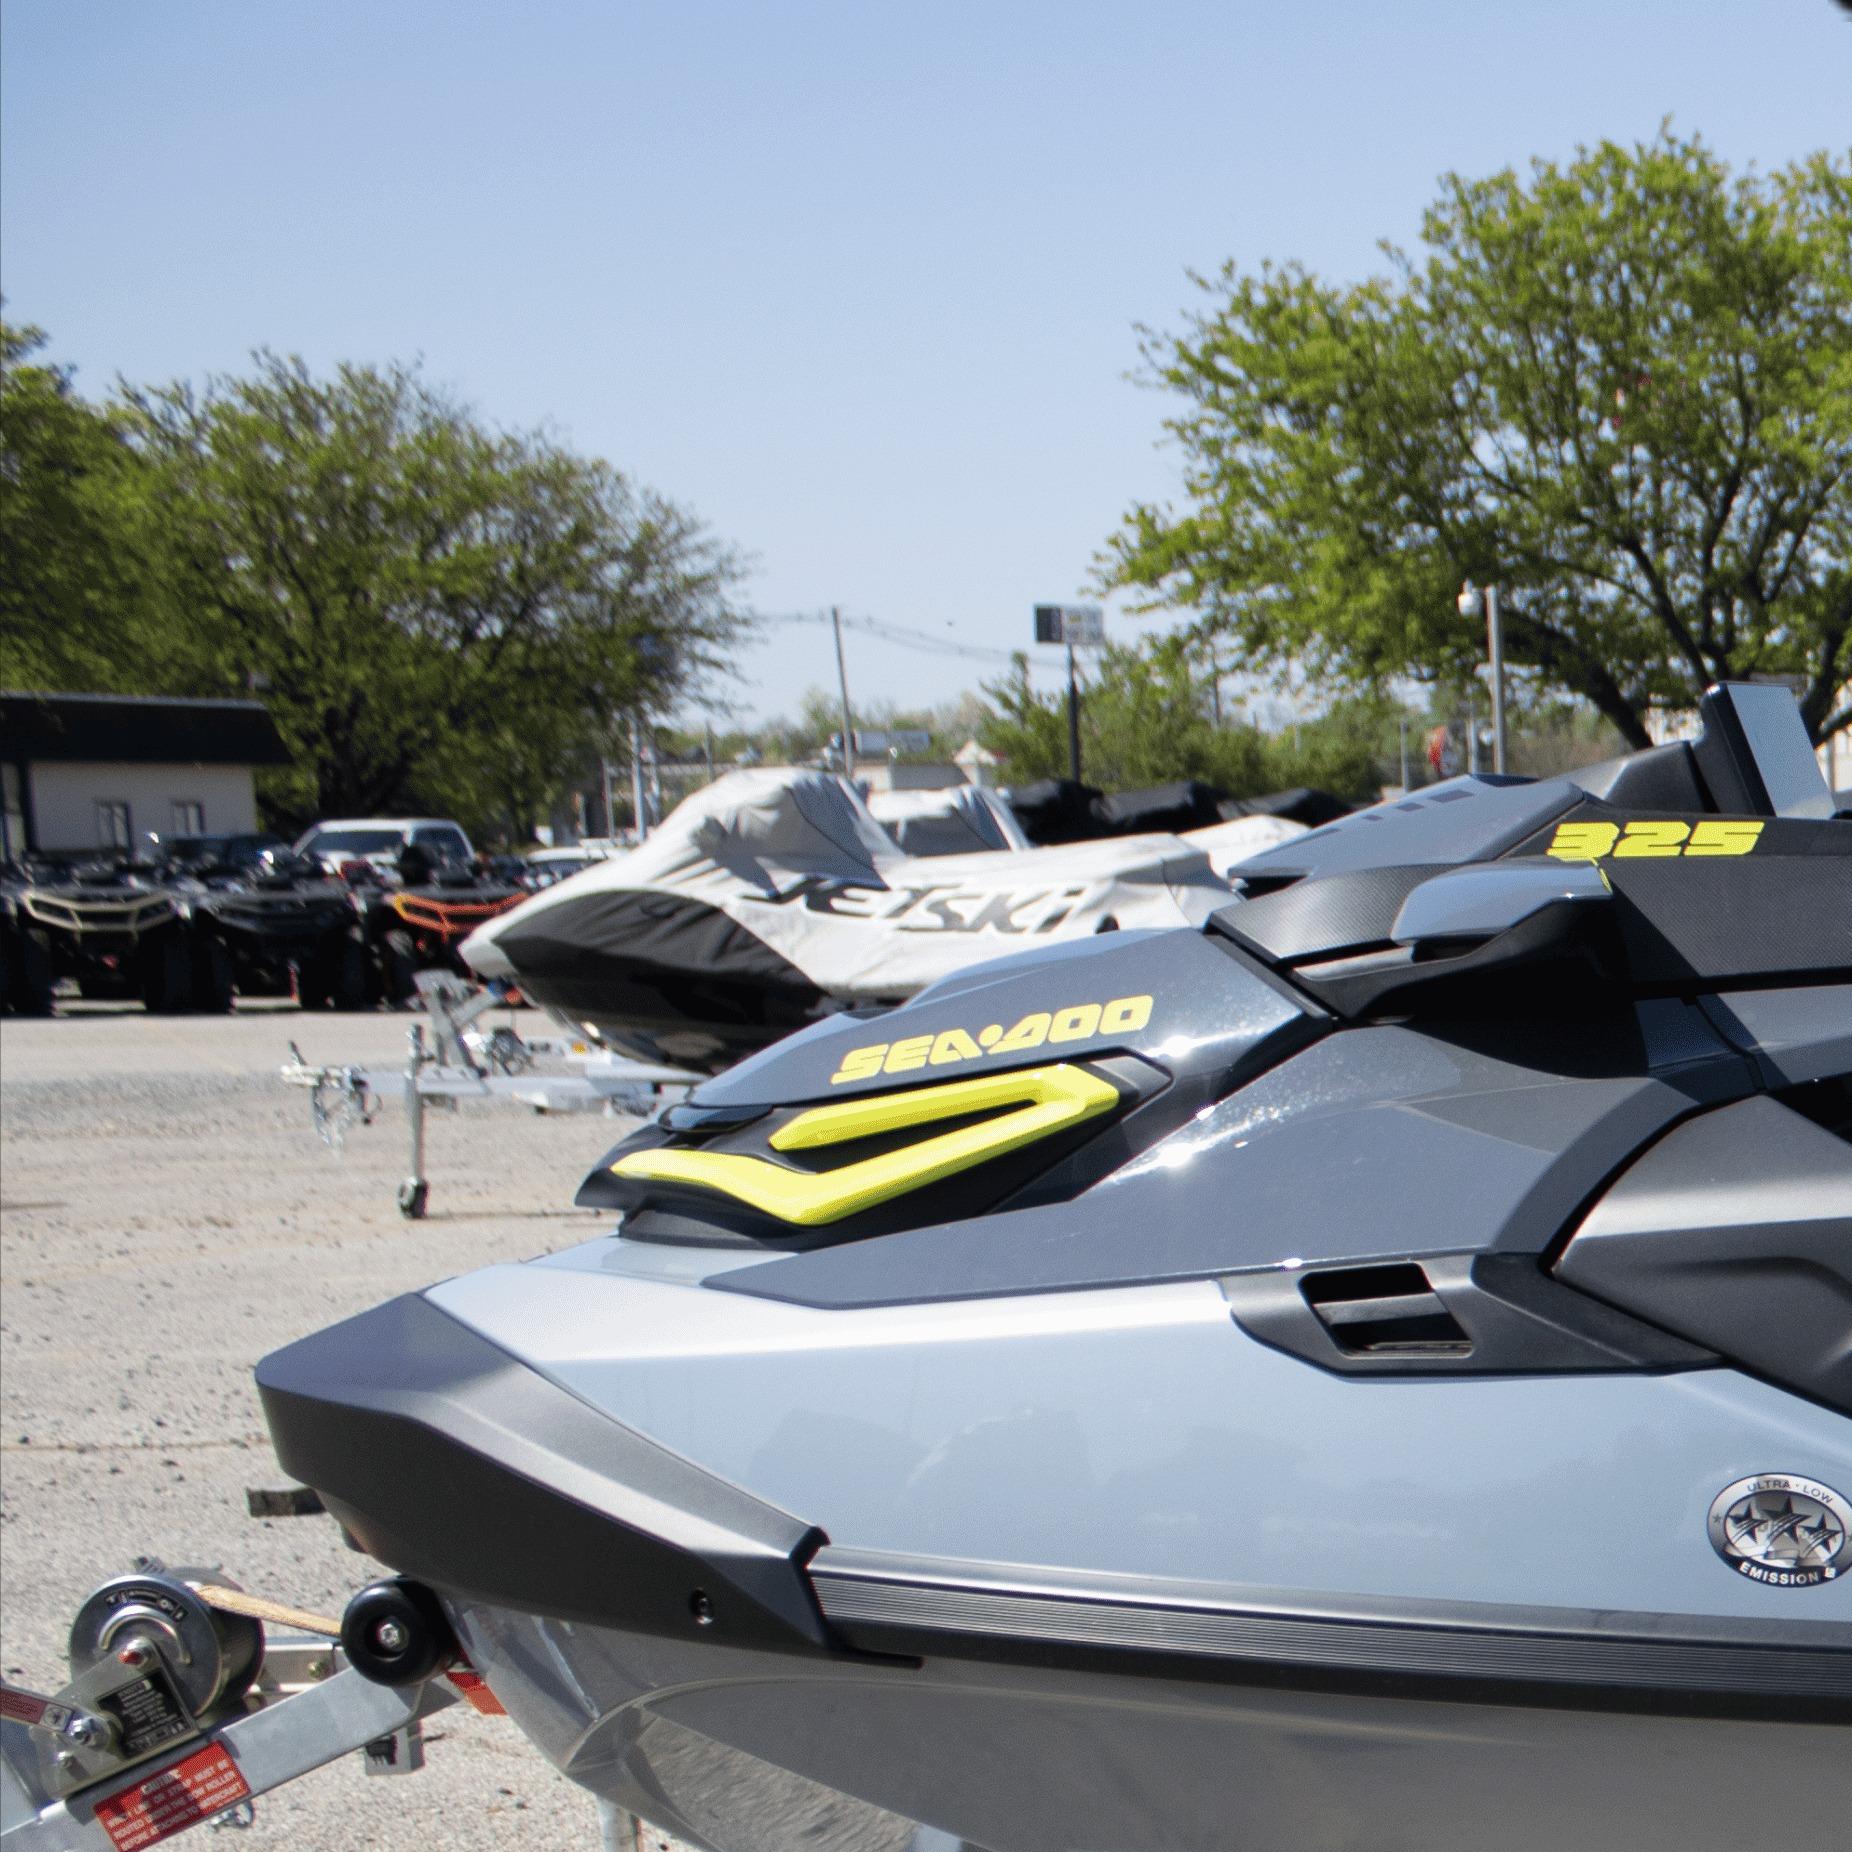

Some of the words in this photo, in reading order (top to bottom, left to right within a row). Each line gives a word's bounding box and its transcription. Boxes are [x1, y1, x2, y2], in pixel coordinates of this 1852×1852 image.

[1546, 821, 1765, 857] 325
[1747, 1479, 1791, 1493] ULTRA
[1803, 1485, 1833, 1504] LOW
[1739, 1561, 1820, 1585] EMISSION
